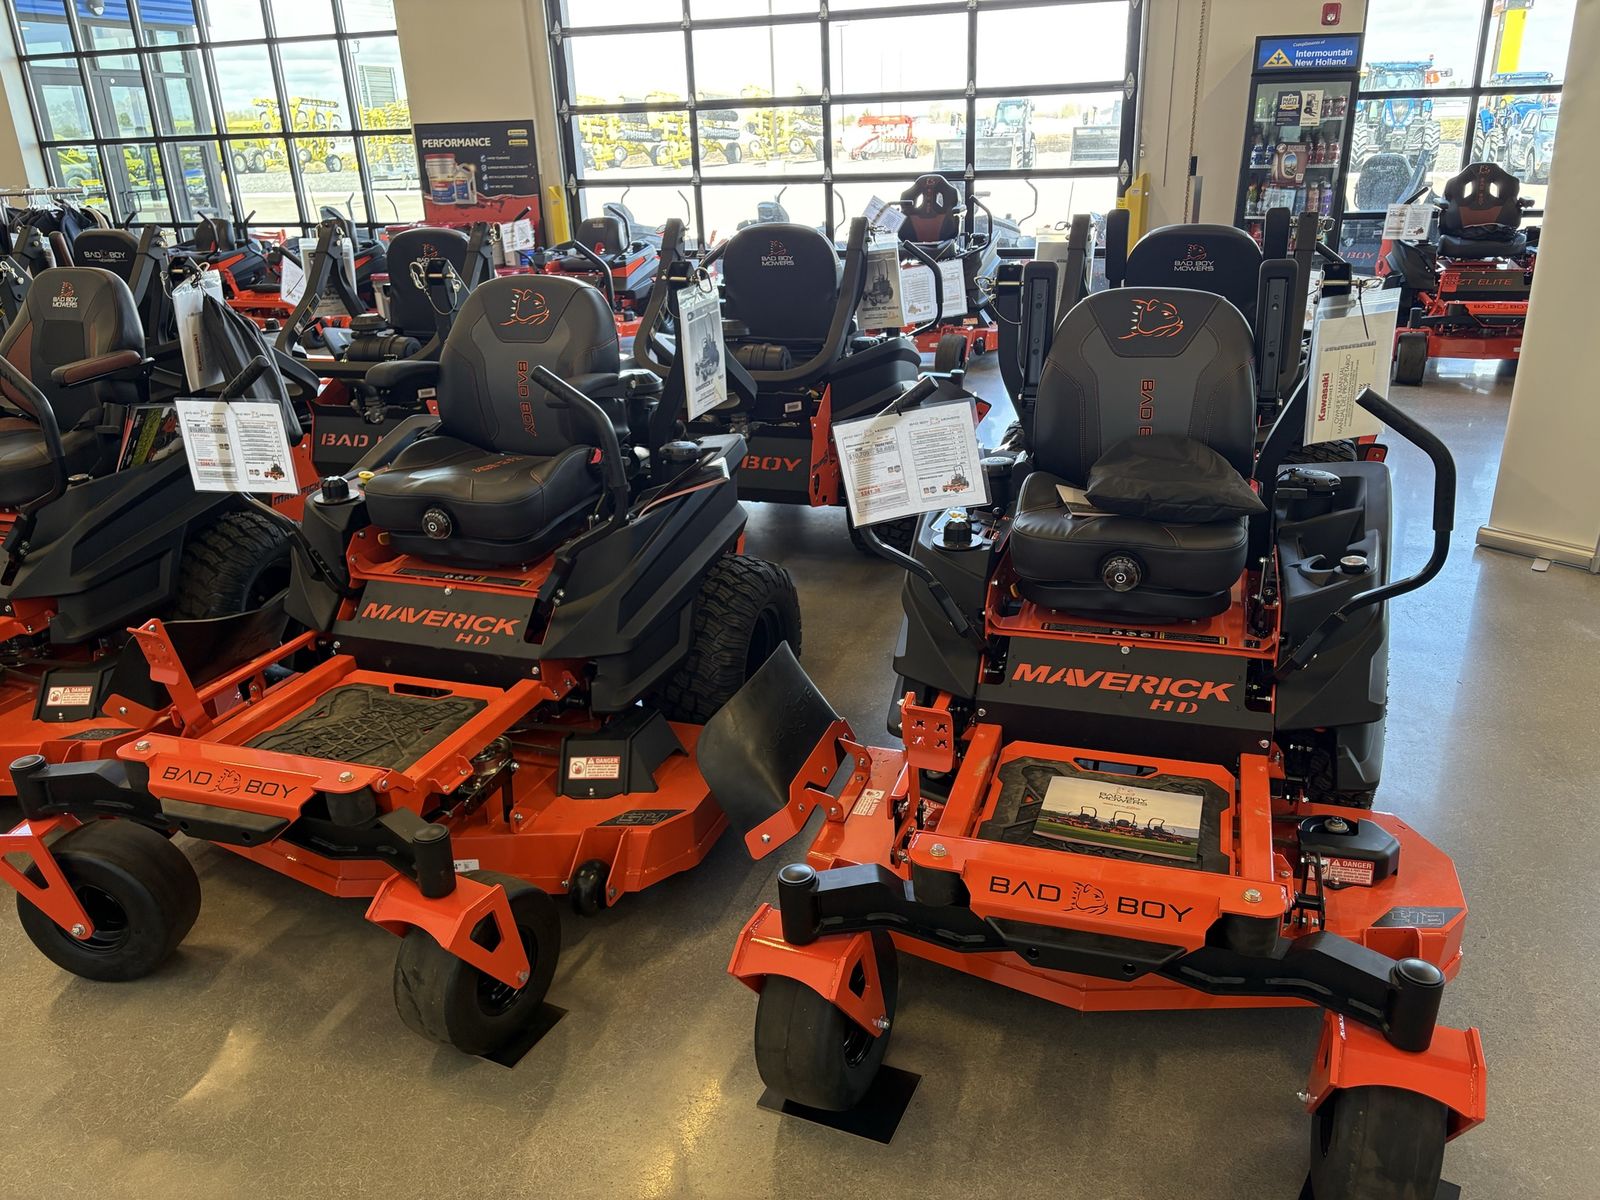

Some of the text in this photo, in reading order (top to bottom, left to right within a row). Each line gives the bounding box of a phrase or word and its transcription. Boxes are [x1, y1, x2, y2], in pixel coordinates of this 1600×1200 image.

[1296, 49, 1353, 57] Intermountain
[1295, 58, 1346, 66] New Holland
[422, 138, 491, 148] PERFORMANCE
[517, 360, 537, 437] BAD BOY
[1140, 379, 1156, 420] BAD
[1318, 373, 1329, 421] Kawasaki
[321, 433, 368, 447] BAD
[741, 455, 802, 471] BOY
[361, 603, 521, 636] MAVERICK
[455, 633, 491, 646] HD
[1012, 663, 1236, 702] MAVERICK
[1150, 699, 1198, 714] HD
[162, 766, 297, 798] BAD BOY
[1099, 796, 1147, 806] MOWERS
[1343, 861, 1372, 869] DANGER
[990, 876, 1193, 923] BAD BOY
